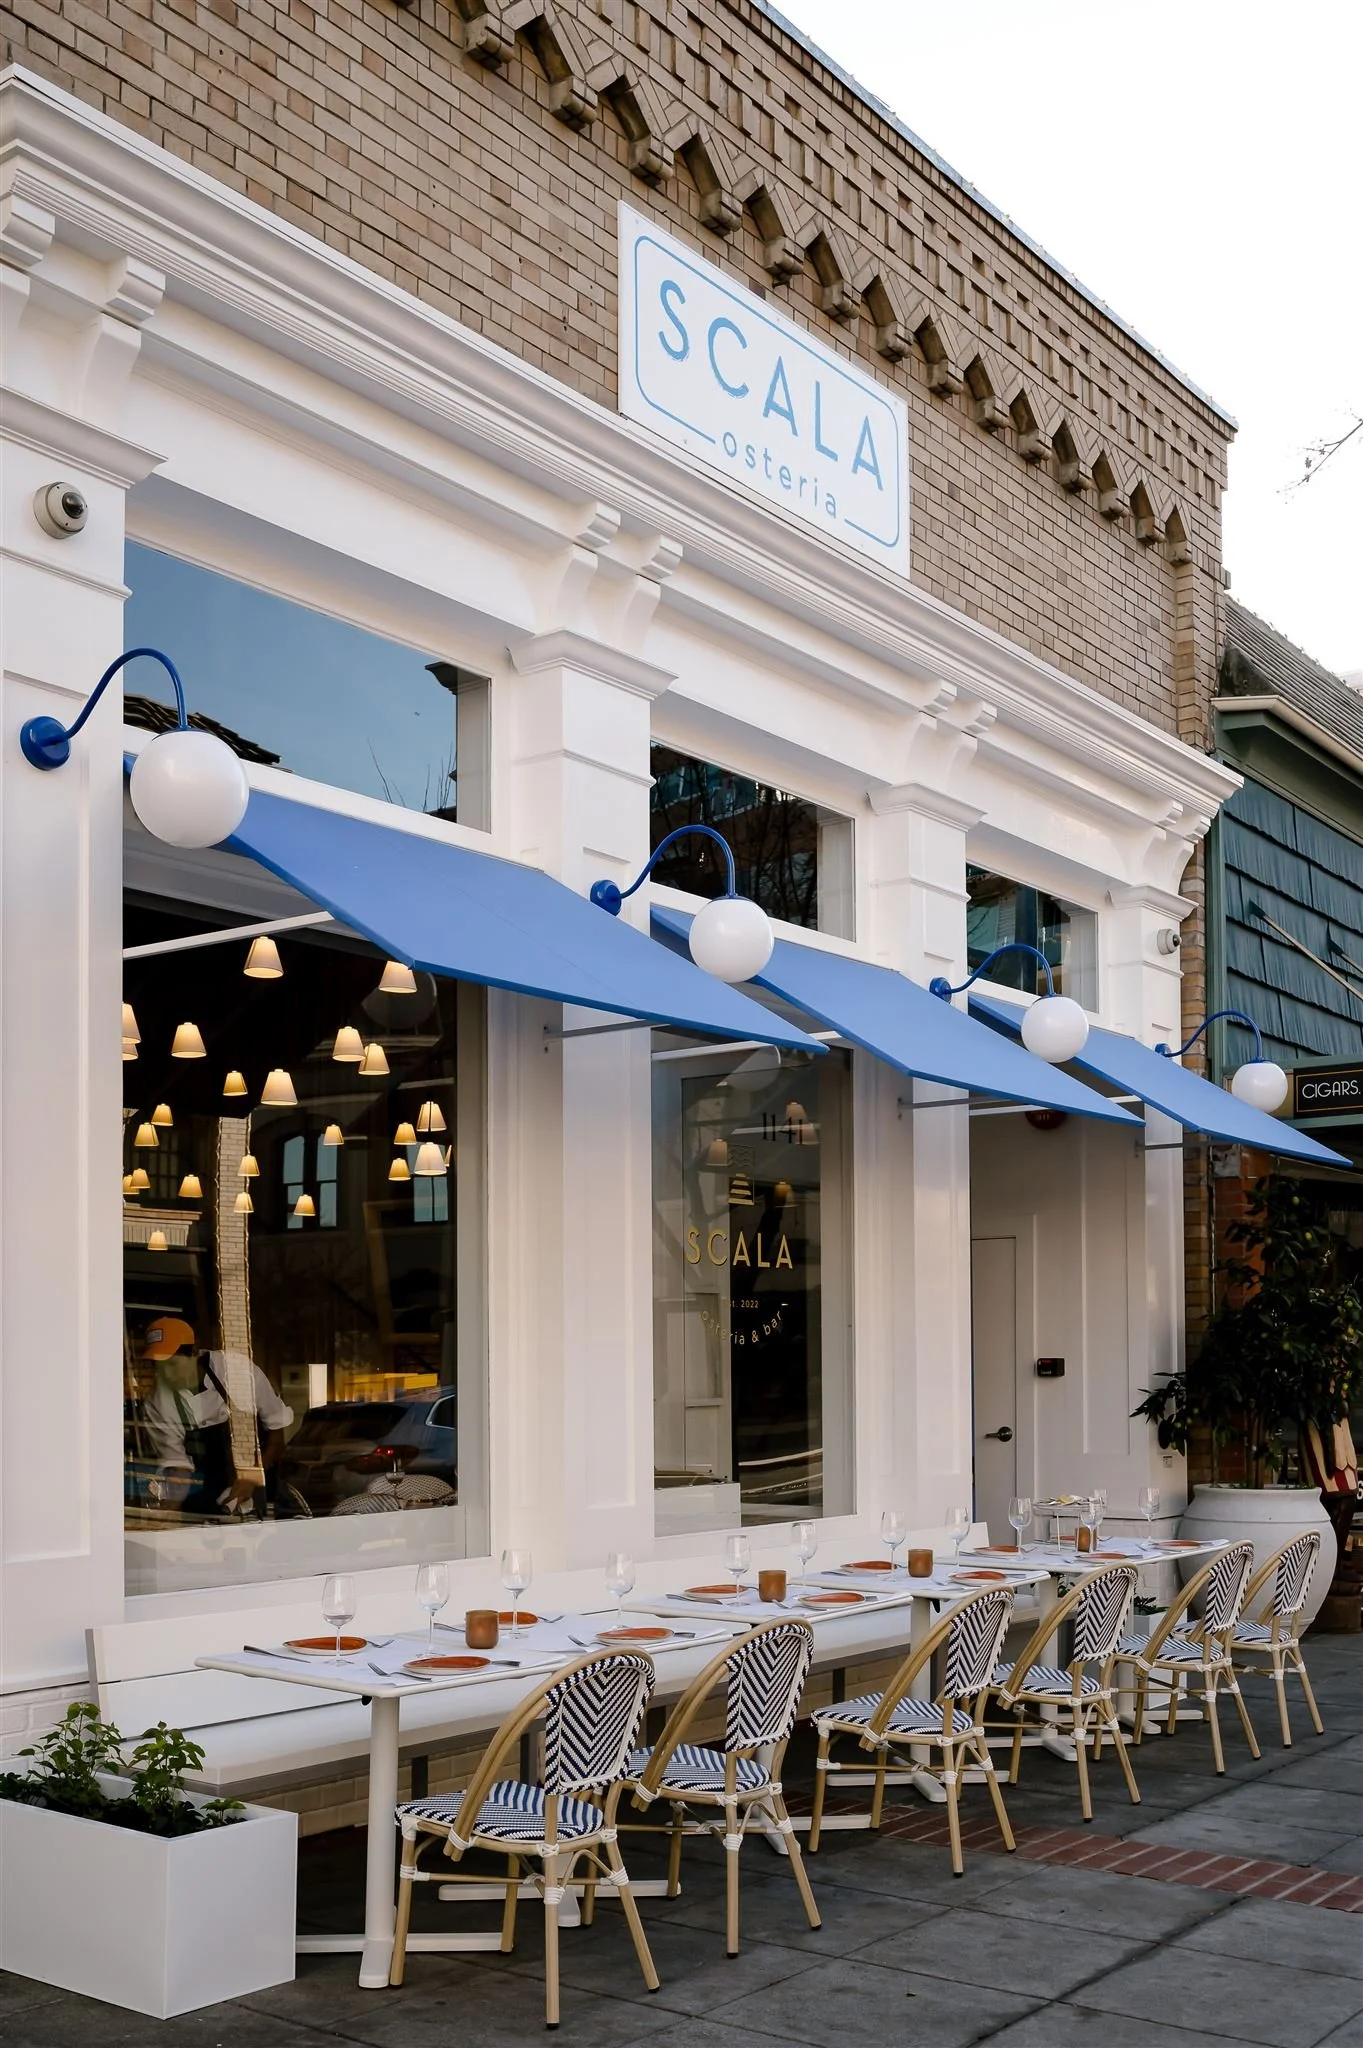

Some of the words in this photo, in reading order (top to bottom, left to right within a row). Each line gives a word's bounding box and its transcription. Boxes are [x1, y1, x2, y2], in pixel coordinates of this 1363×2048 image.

[658, 279, 884, 491] SCALA
[722, 431, 838, 519] osteria
[1301, 1080, 1361, 1099] CIGARS.
[762, 1112, 803, 1145] 1141
[686, 1226, 793, 1269] SCALA
[740, 1299, 759, 1309] 2022
[751, 1330, 760, 1343] &
[763, 1310, 782, 1336] bar
